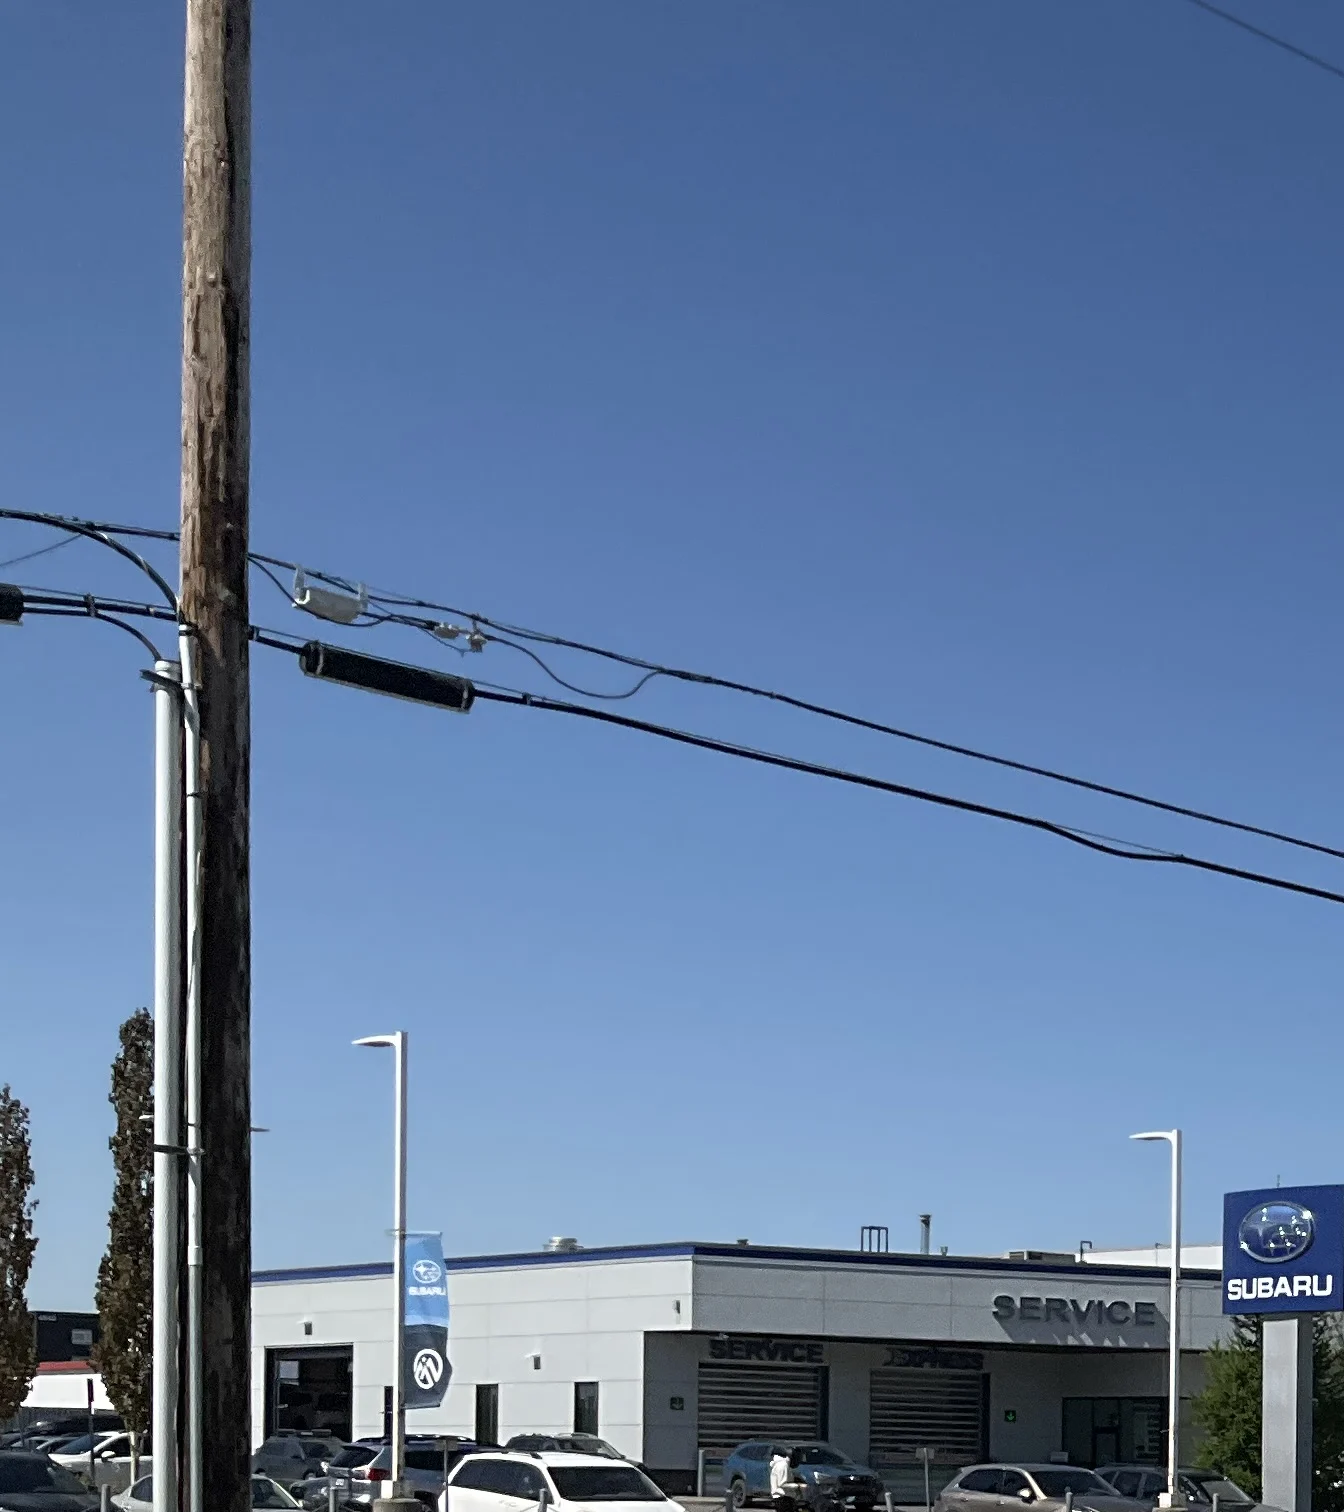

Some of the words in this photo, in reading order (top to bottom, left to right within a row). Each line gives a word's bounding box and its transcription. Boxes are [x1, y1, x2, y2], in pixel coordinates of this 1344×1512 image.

[1227, 1274, 1333, 1301] SUBARU
[992, 1294, 1156, 1326] SERVICE
[708, 1338, 824, 1364] SERVICE
